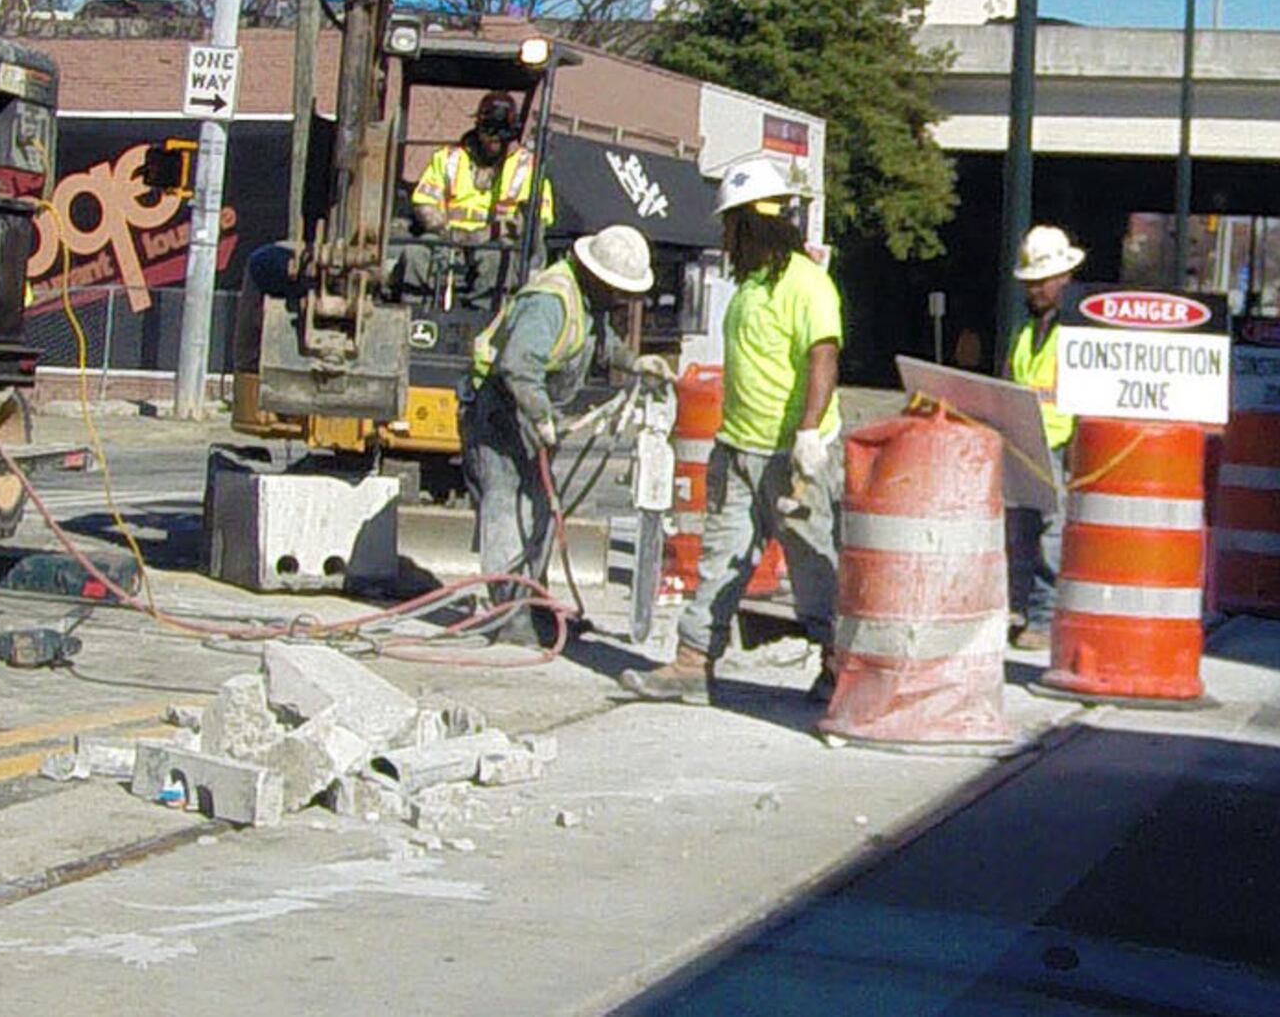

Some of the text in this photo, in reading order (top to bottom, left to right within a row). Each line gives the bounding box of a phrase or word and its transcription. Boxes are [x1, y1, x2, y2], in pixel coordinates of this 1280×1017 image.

[193, 50, 234, 70] ONE
[191, 73, 232, 91] WAY
[1101, 298, 1190, 322] DANGER
[1066, 339, 1222, 377] CONSTRUCTION
[1116, 379, 1171, 412] ZONE
